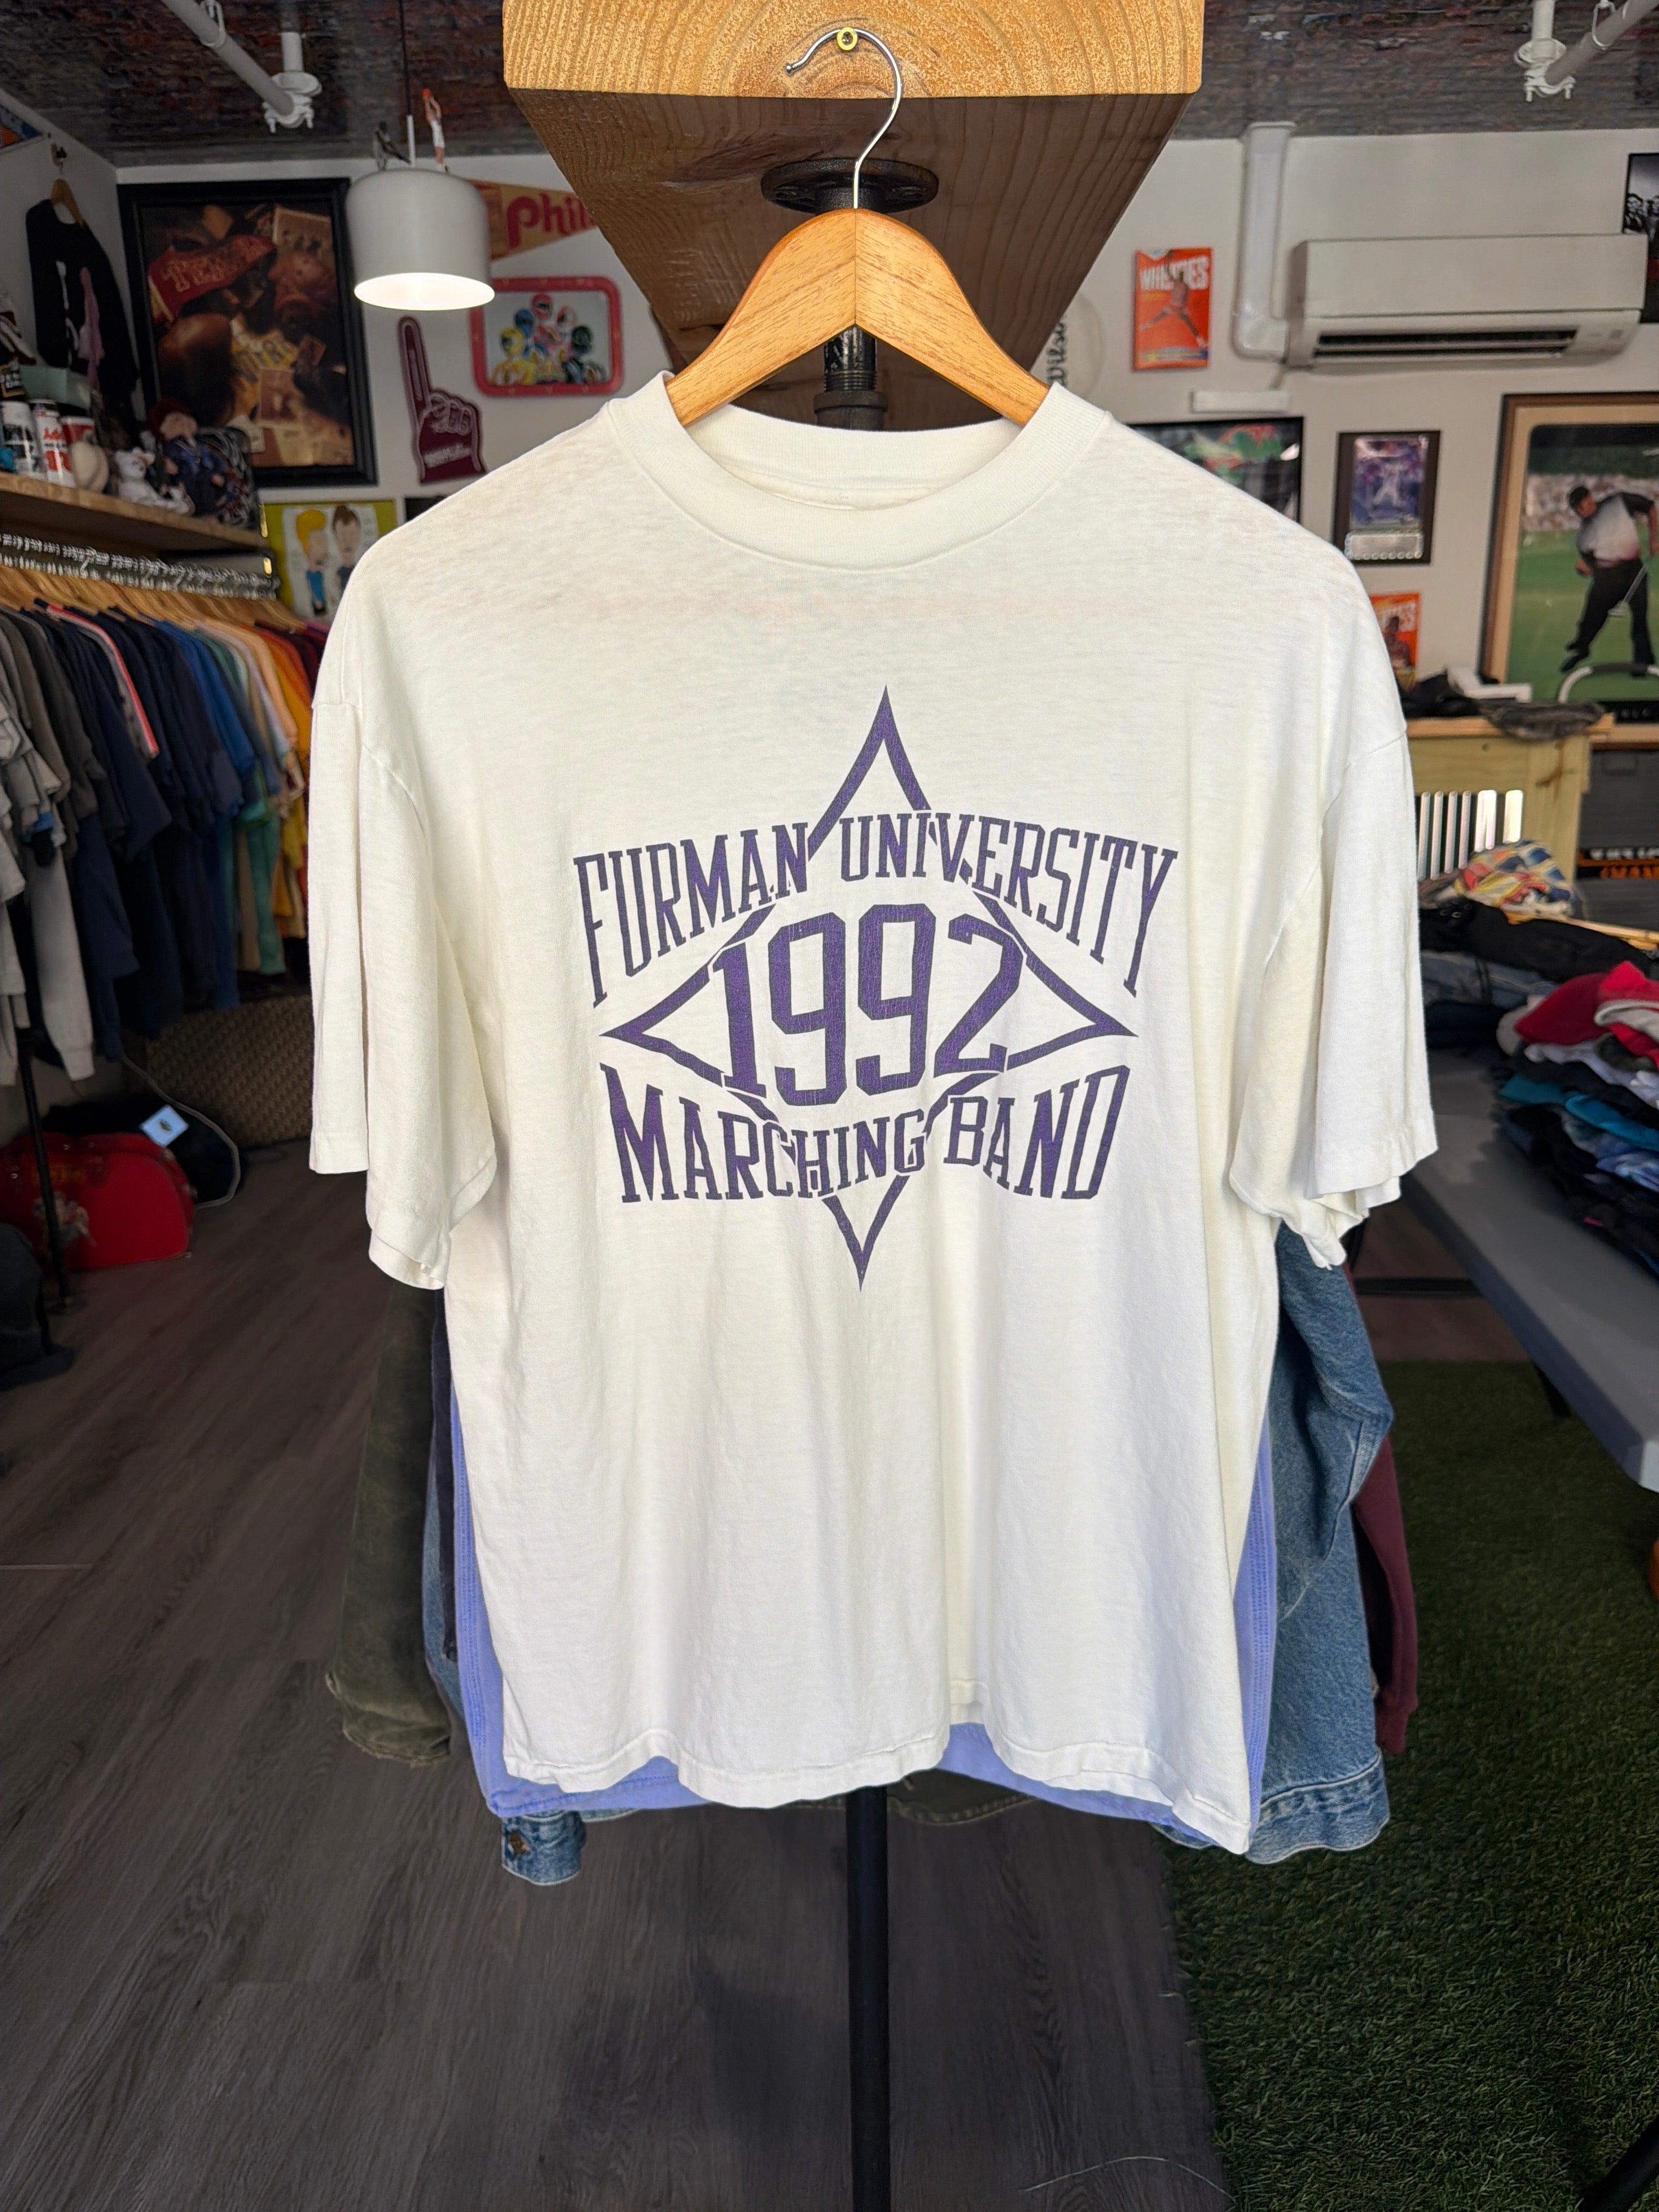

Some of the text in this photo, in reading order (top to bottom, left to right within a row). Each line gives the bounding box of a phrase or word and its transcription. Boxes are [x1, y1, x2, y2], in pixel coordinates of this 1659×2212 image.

[1046, 321, 1065, 387] Wilso
[573, 812, 1179, 1009] FURMAN UNIVERSITY
[713, 903, 1023, 1106] 1992
[600, 1062, 1131, 1203] MARCHING BAND
